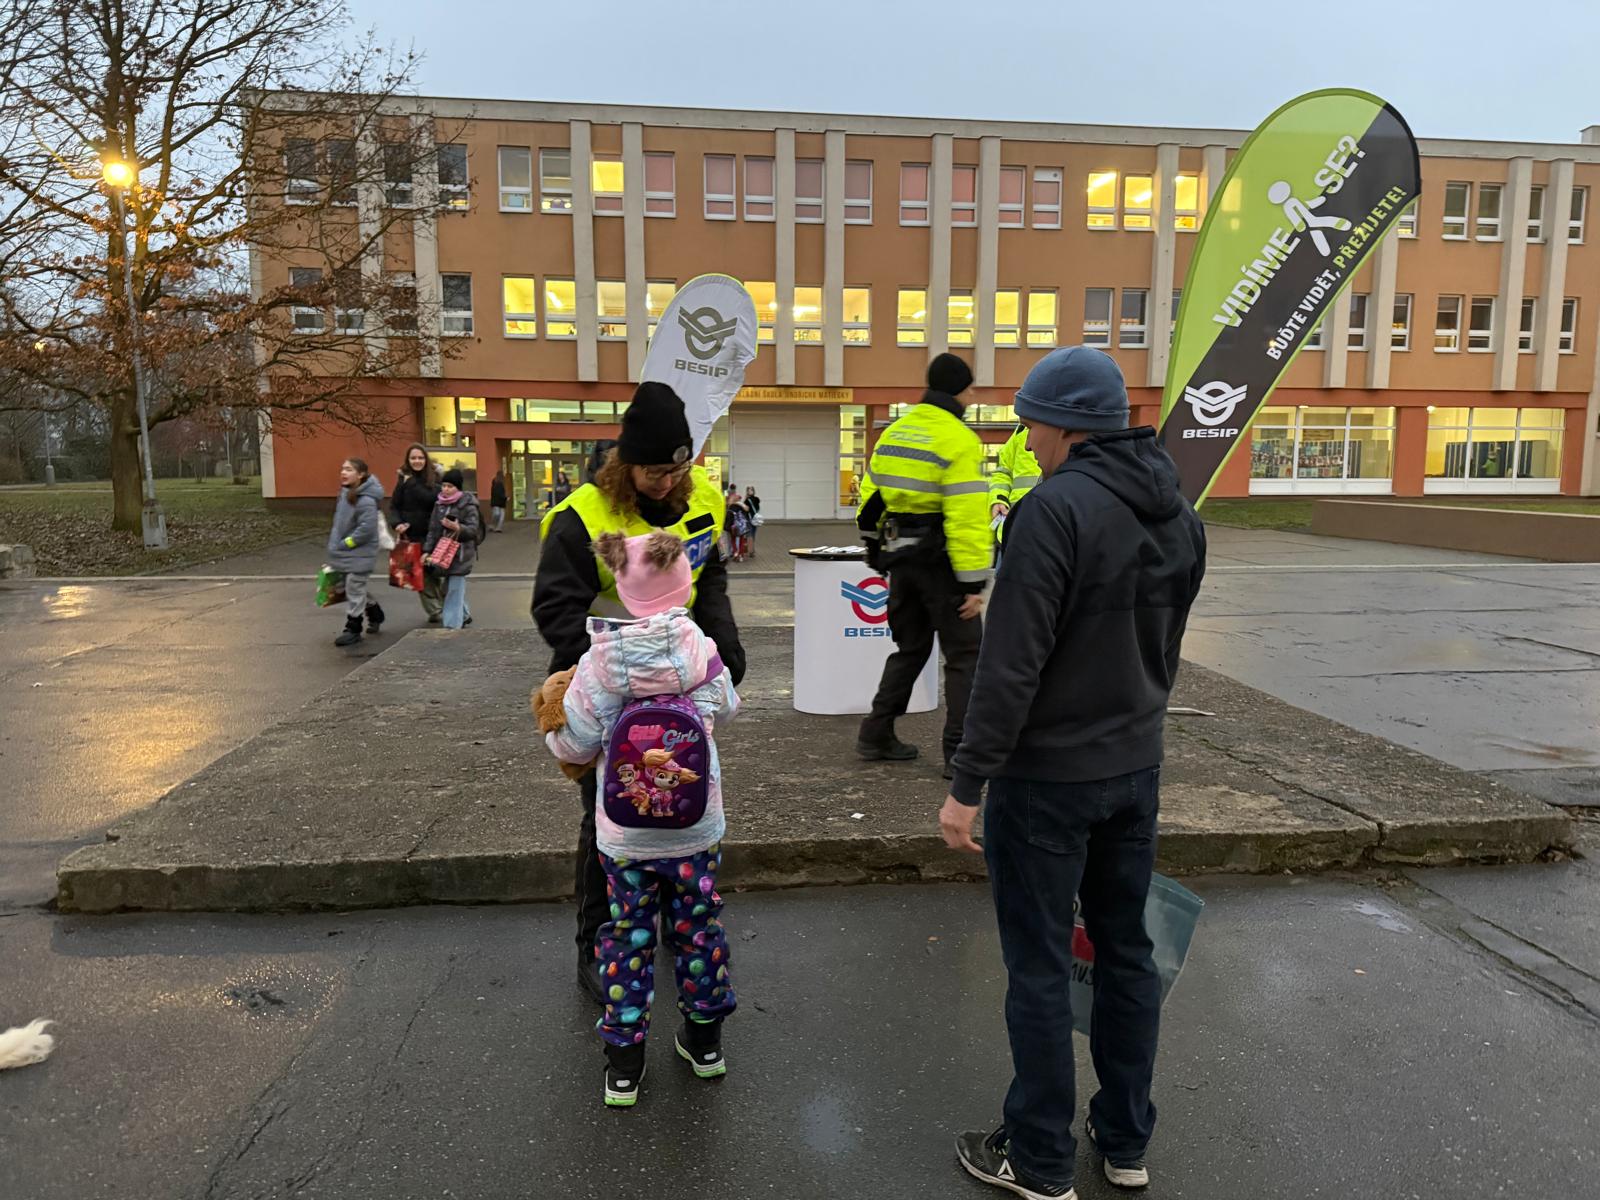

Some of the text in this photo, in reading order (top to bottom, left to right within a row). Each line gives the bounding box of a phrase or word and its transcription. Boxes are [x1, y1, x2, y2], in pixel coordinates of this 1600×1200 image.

[1212, 135, 1366, 328] VIDÍME SE?
[1266, 186, 1408, 360] BUĎTE VIDĚT, PŘEŽIJETE!
[674, 358, 729, 378] BESIP
[1182, 428, 1239, 439] BESIP
[844, 627, 891, 638] BESI
[662, 729, 700, 752] Girls
